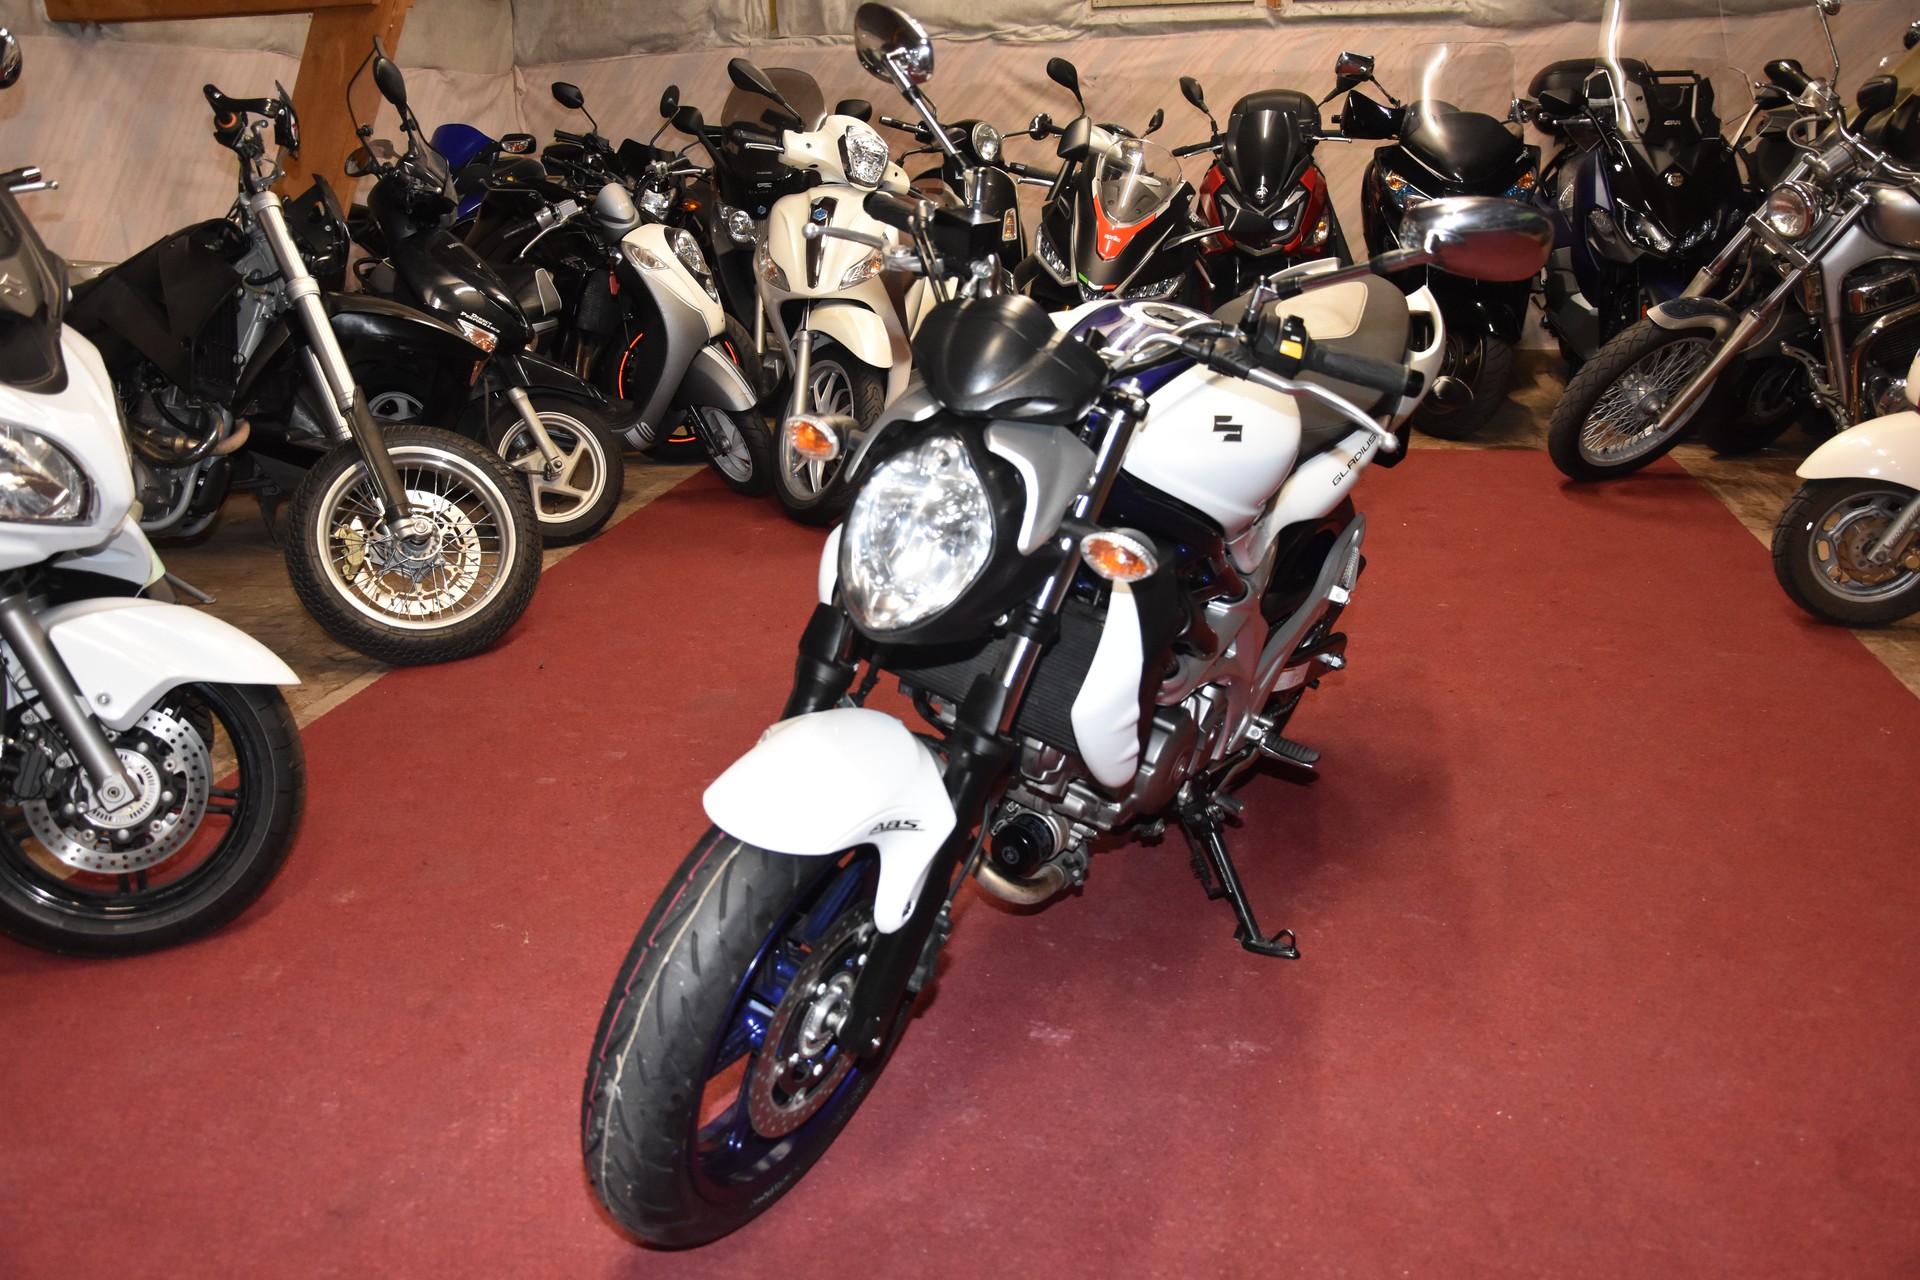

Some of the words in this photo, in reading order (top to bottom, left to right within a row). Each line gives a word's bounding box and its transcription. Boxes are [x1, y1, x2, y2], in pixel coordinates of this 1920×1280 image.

[1103, 233, 1121, 243] aprilia
[1332, 432, 1377, 486] GLADIUS
[868, 819, 921, 836] ABS
